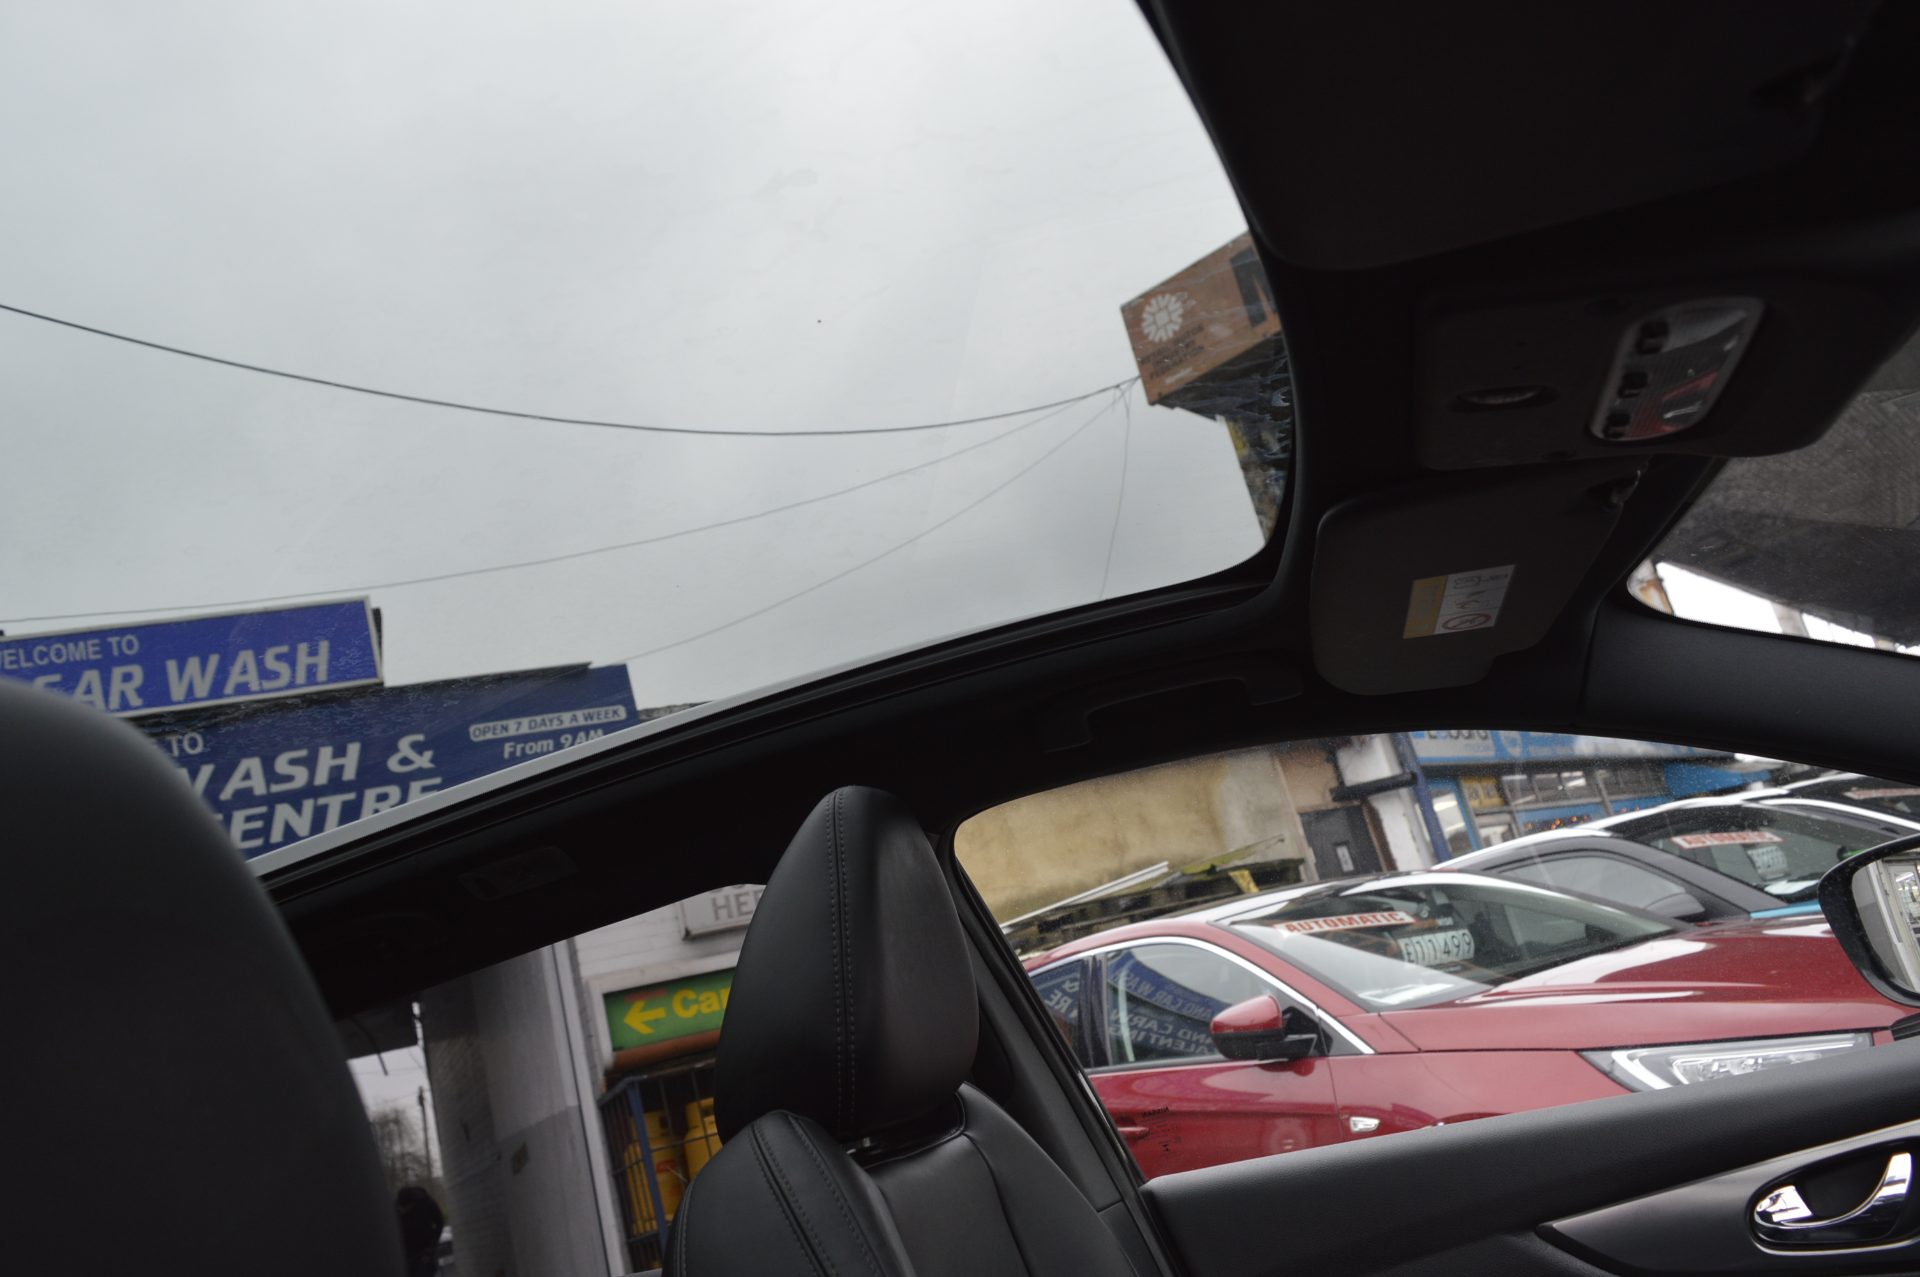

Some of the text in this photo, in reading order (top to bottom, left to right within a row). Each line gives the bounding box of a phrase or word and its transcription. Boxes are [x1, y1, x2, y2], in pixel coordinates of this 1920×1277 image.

[0, 634, 140, 670] ELCOME TO
[165, 640, 331, 703] WASH
[472, 707, 621, 740] OPEN 7 DAYS A WEEK
[166, 732, 204, 757] TO
[386, 733, 436, 773] &
[503, 739, 555, 760] From
[215, 777, 443, 851] ENTR
[1285, 911, 1406, 933] AUTOMATIC
